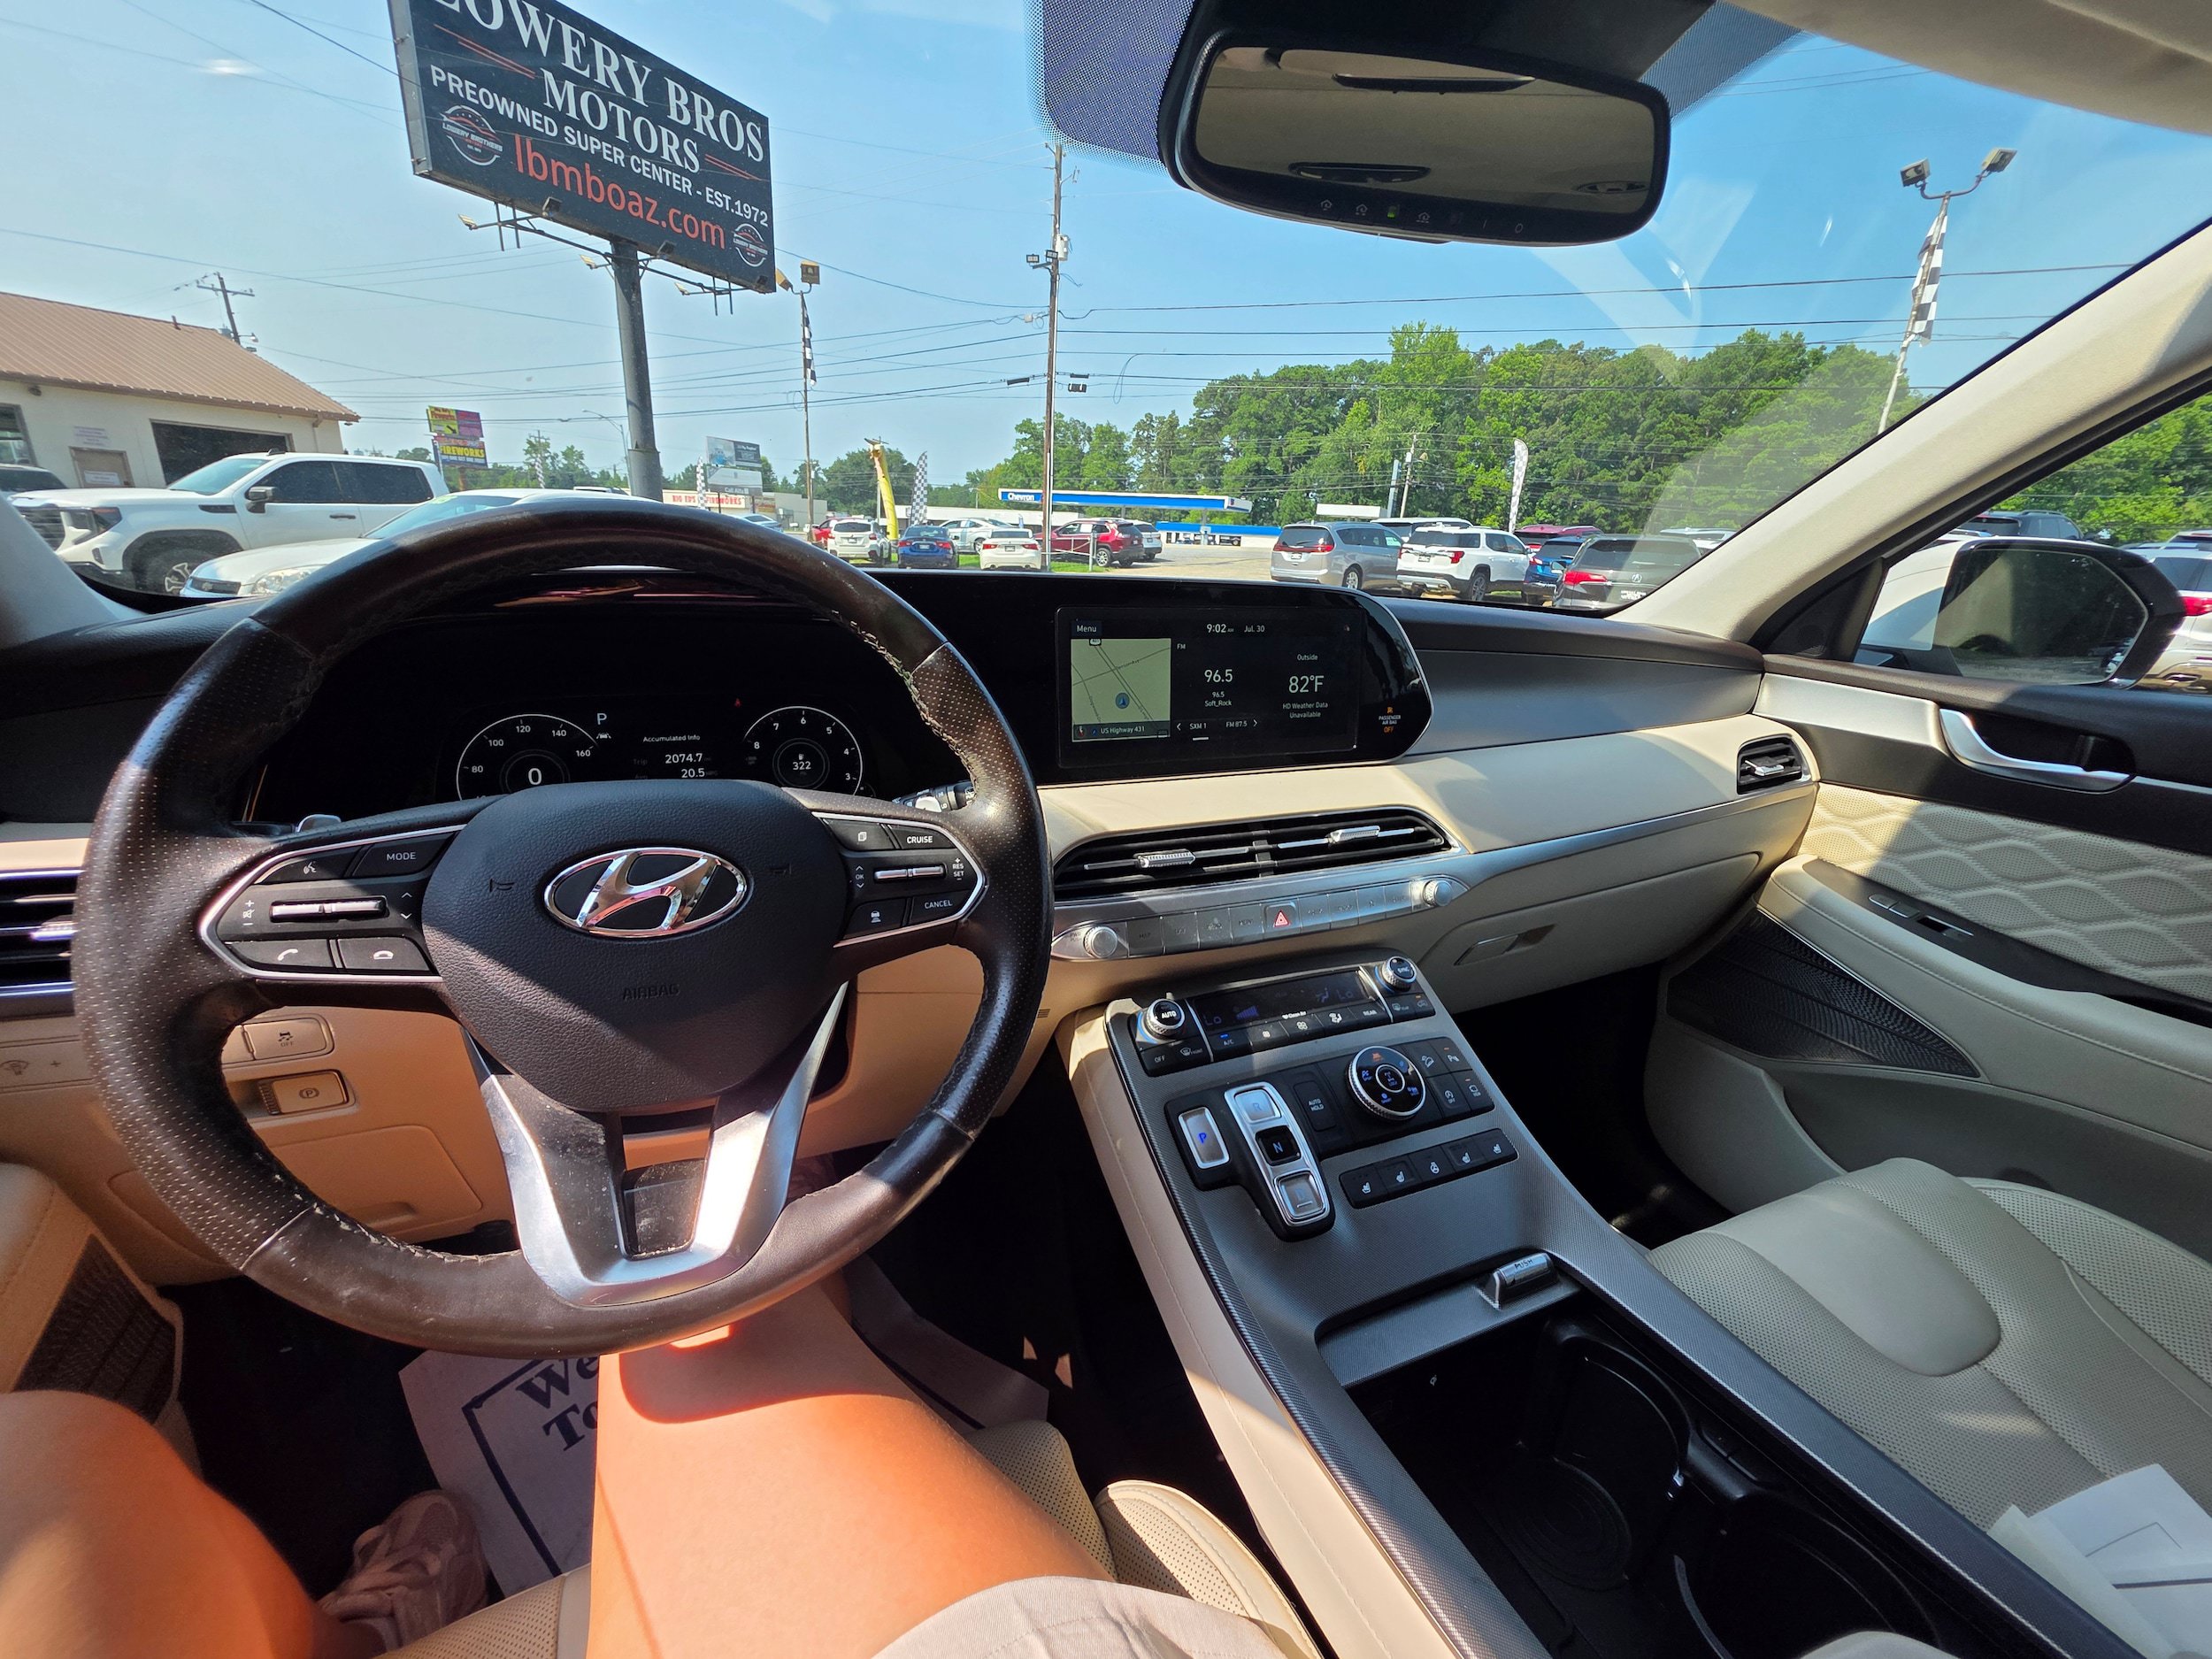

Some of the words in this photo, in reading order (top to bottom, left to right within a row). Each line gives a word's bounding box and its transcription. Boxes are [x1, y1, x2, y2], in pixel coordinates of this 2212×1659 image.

[444, 0, 652, 108] OWERY
[664, 76, 764, 163] BROS
[540, 67, 701, 173] MOTORS
[430, 65, 558, 137] PREOWNED
[564, 125, 626, 168] SUPER
[630, 155, 693, 196] CENTER
[705, 187, 769, 227] EST.1972
[513, 133, 726, 250] lbmboaz.com
[1206, 623, 1227, 634] 9:02
[1204, 668, 1233, 683] 96.5
[1288, 674, 1325, 694] 82°F
[596, 712, 608, 726] P
[516, 725, 531, 733] 120
[772, 722, 779, 731] 7
[1110, 726, 1134, 736] Highway
[664, 752, 703, 764] 2074.7
[792, 760, 811, 771] 322
[527, 767, 542, 785] 0
[680, 767, 705, 779] 20.5
[906, 835, 933, 844] CRUISE
[386, 851, 417, 861] MODE
[924, 900, 953, 910] CANCEL
[622, 983, 680, 1001] AIRBAG
[1161, 1010, 1177, 1019] AUTO
[1252, 1102, 1262, 1111] R
[1310, 1103, 1325, 1112] HOLD
[1198, 1132, 1207, 1144] P
[1272, 1141, 1284, 1153] N
[1514, 1258, 1533, 1271] PUSH
